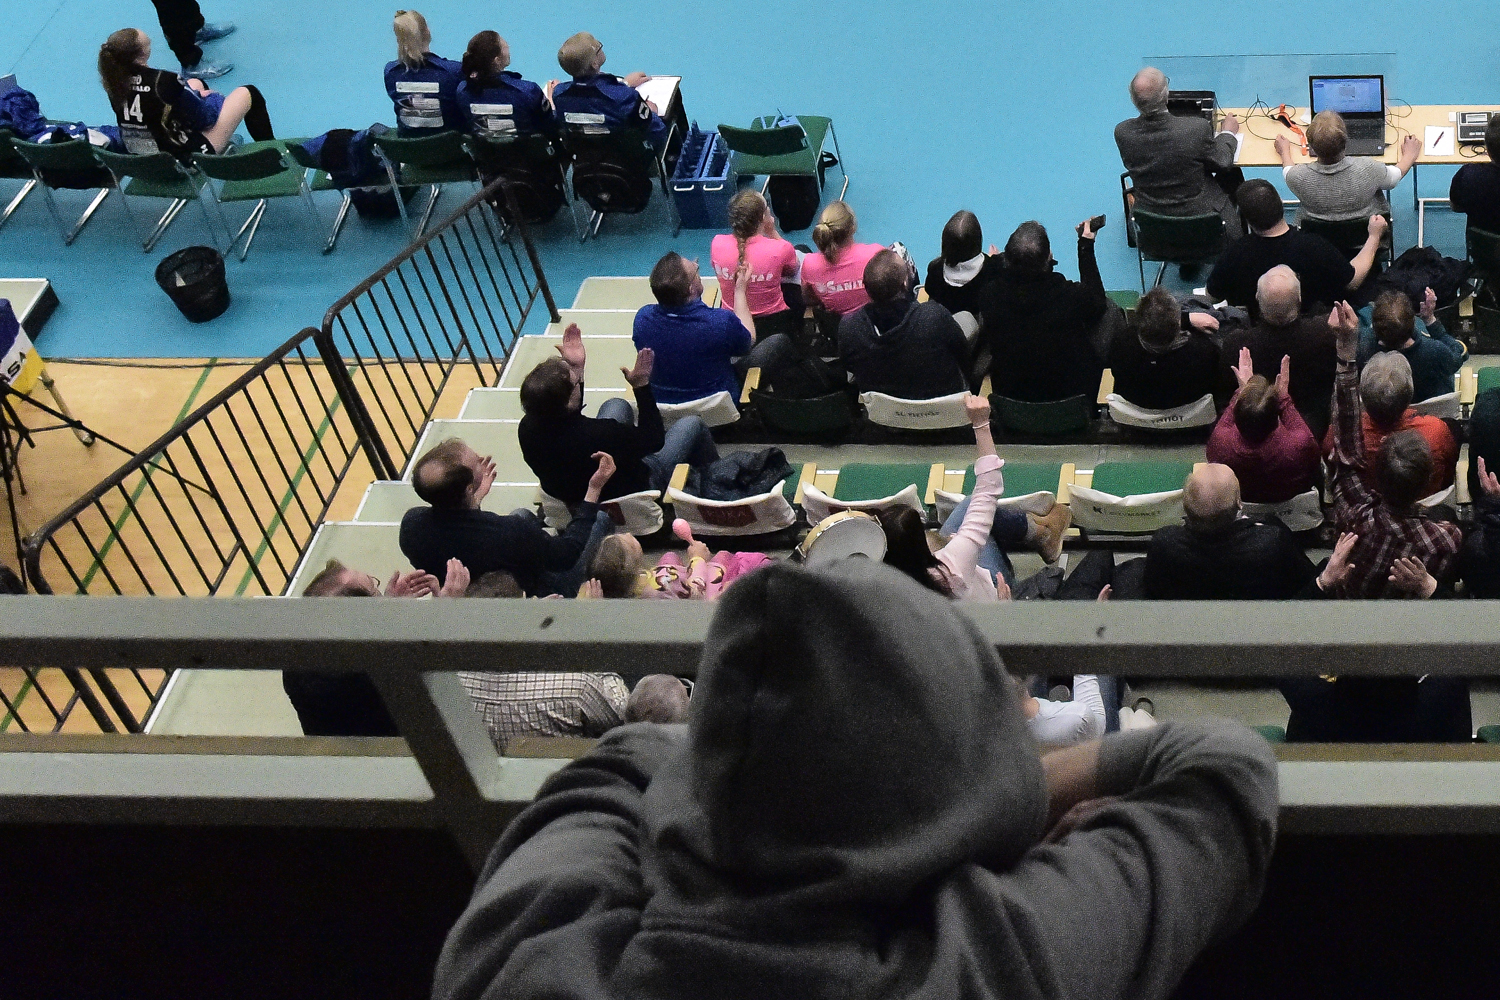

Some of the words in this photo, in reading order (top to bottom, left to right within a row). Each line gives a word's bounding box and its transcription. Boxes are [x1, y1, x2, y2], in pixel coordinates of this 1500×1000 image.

[123, 94, 143, 122] 14
[721, 267, 773, 283] SATAP
[826, 279, 864, 292] SANIT
